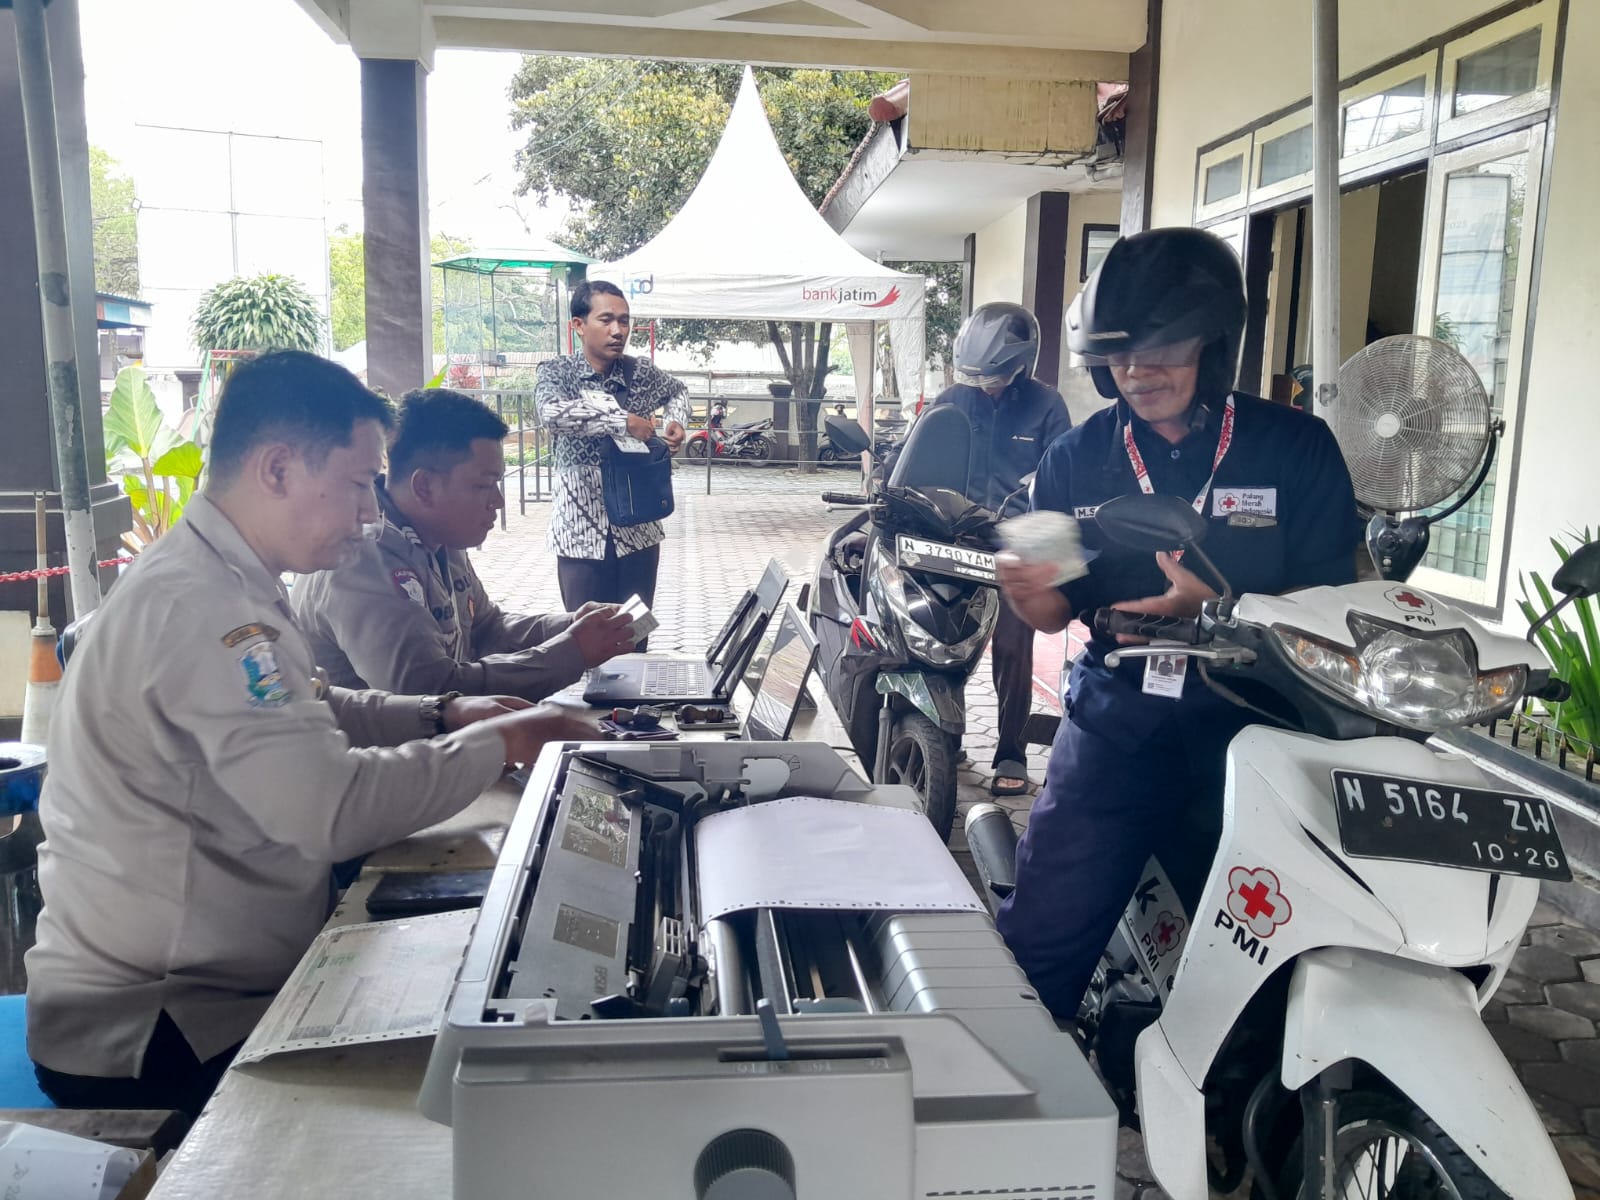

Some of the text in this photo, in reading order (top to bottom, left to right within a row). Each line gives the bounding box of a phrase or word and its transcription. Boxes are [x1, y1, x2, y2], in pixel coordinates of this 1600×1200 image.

[802, 286, 877, 304] bankjatim
[1242, 493, 1264, 501] Palang
[904, 540, 914, 551] N
[965, 553, 993, 568] YAM
[1404, 614, 1437, 626] PMI
[1342, 777, 1551, 835] N 5164 ZW
[1214, 908, 1270, 966] PMI
[1141, 933, 1160, 973] PMI
